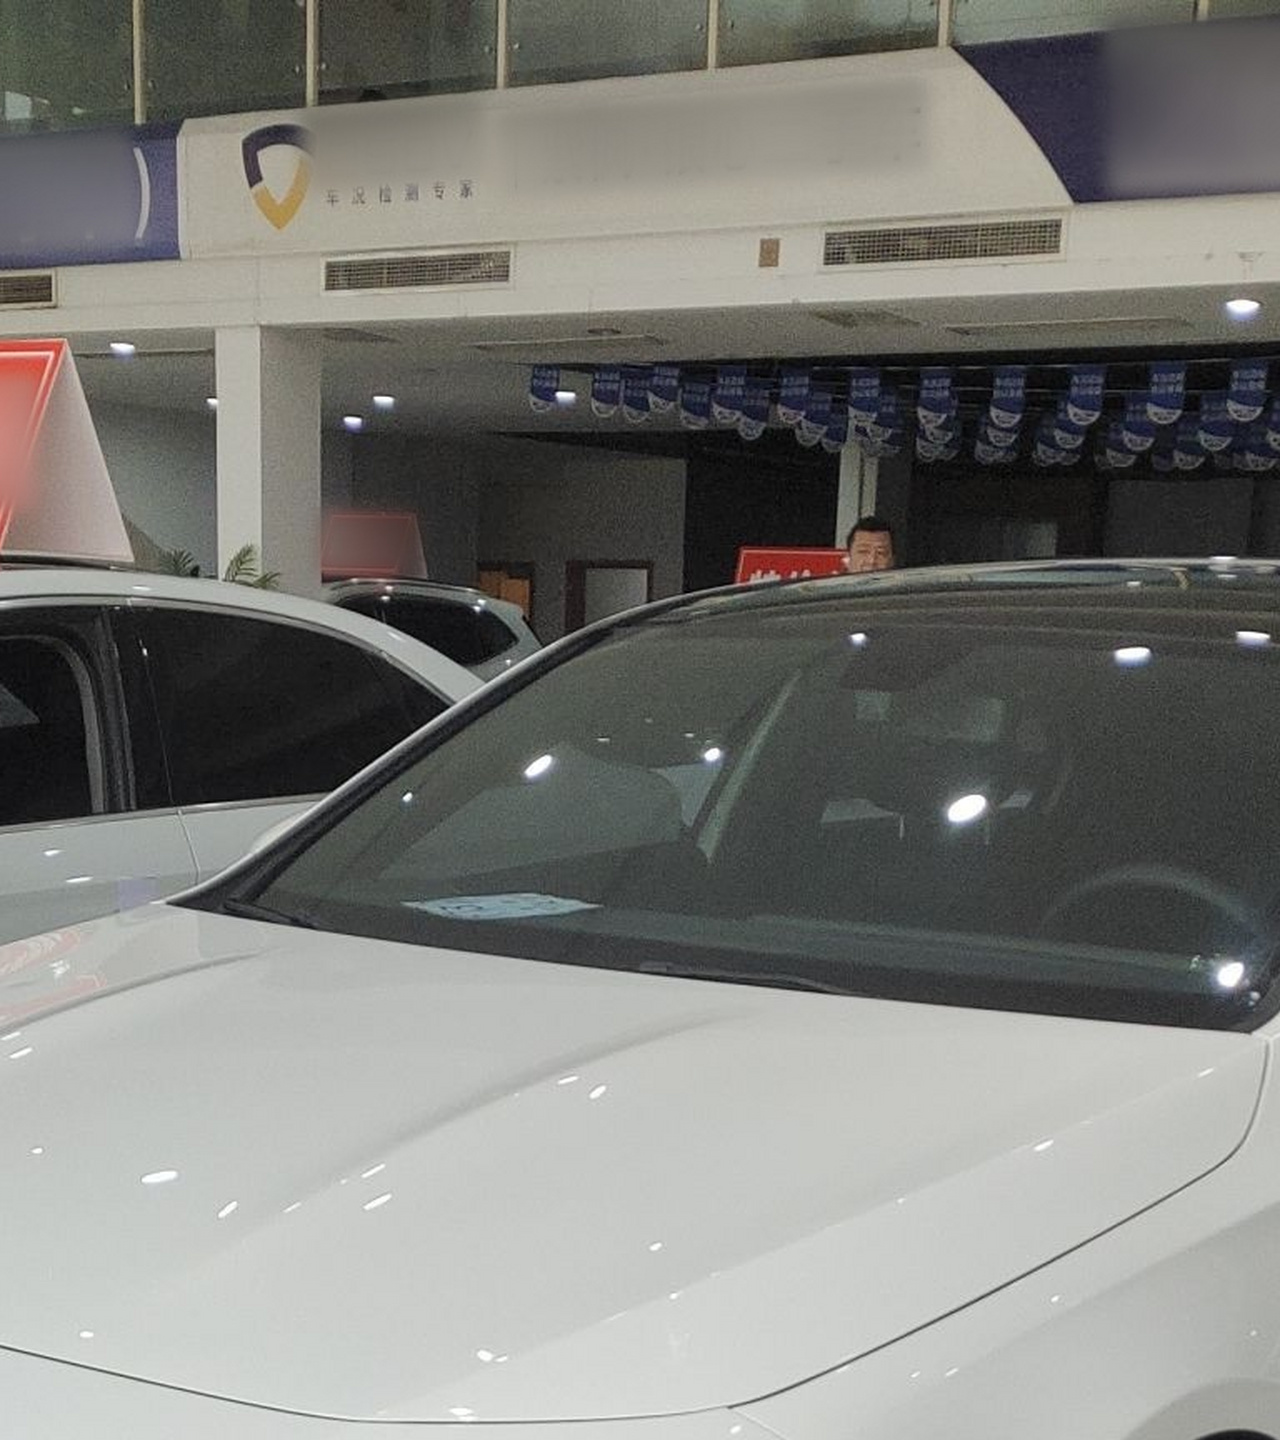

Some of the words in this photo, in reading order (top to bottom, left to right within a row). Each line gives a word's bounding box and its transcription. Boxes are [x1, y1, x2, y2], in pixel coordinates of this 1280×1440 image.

[324, 179, 474, 207] 车况检测专家
